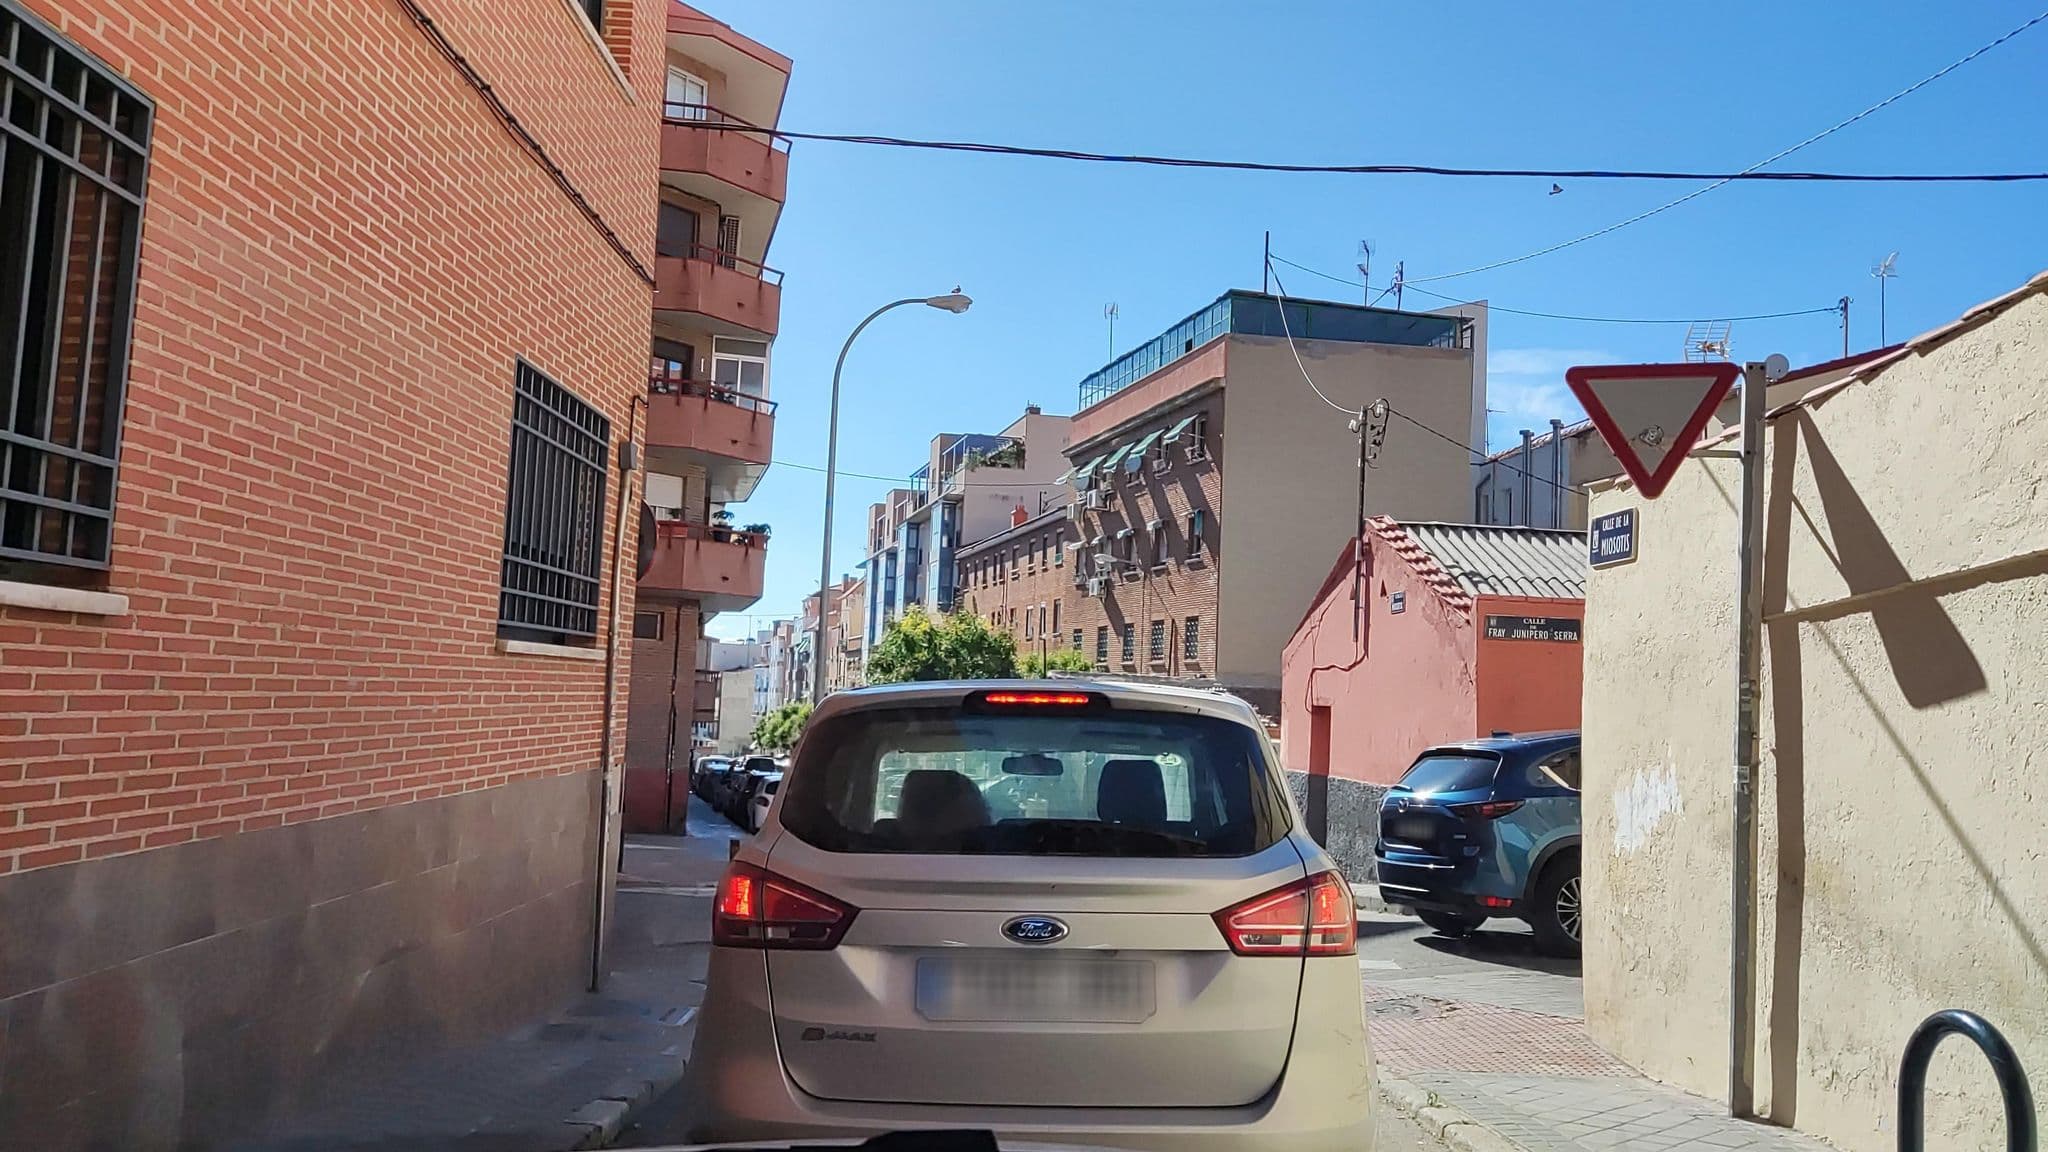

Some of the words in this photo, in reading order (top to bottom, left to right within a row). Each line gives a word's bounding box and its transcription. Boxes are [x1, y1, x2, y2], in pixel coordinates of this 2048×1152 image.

[1602, 517, 1615, 532] CALLE
[1615, 515, 1622, 528] DE
[1623, 513, 1629, 527] LA
[1488, 627, 1506, 638] FRAY
[1511, 629, 1549, 640] JUNIPERO
[1553, 631, 1578, 641] SERRA
[1017, 922, 1052, 937] Ford
